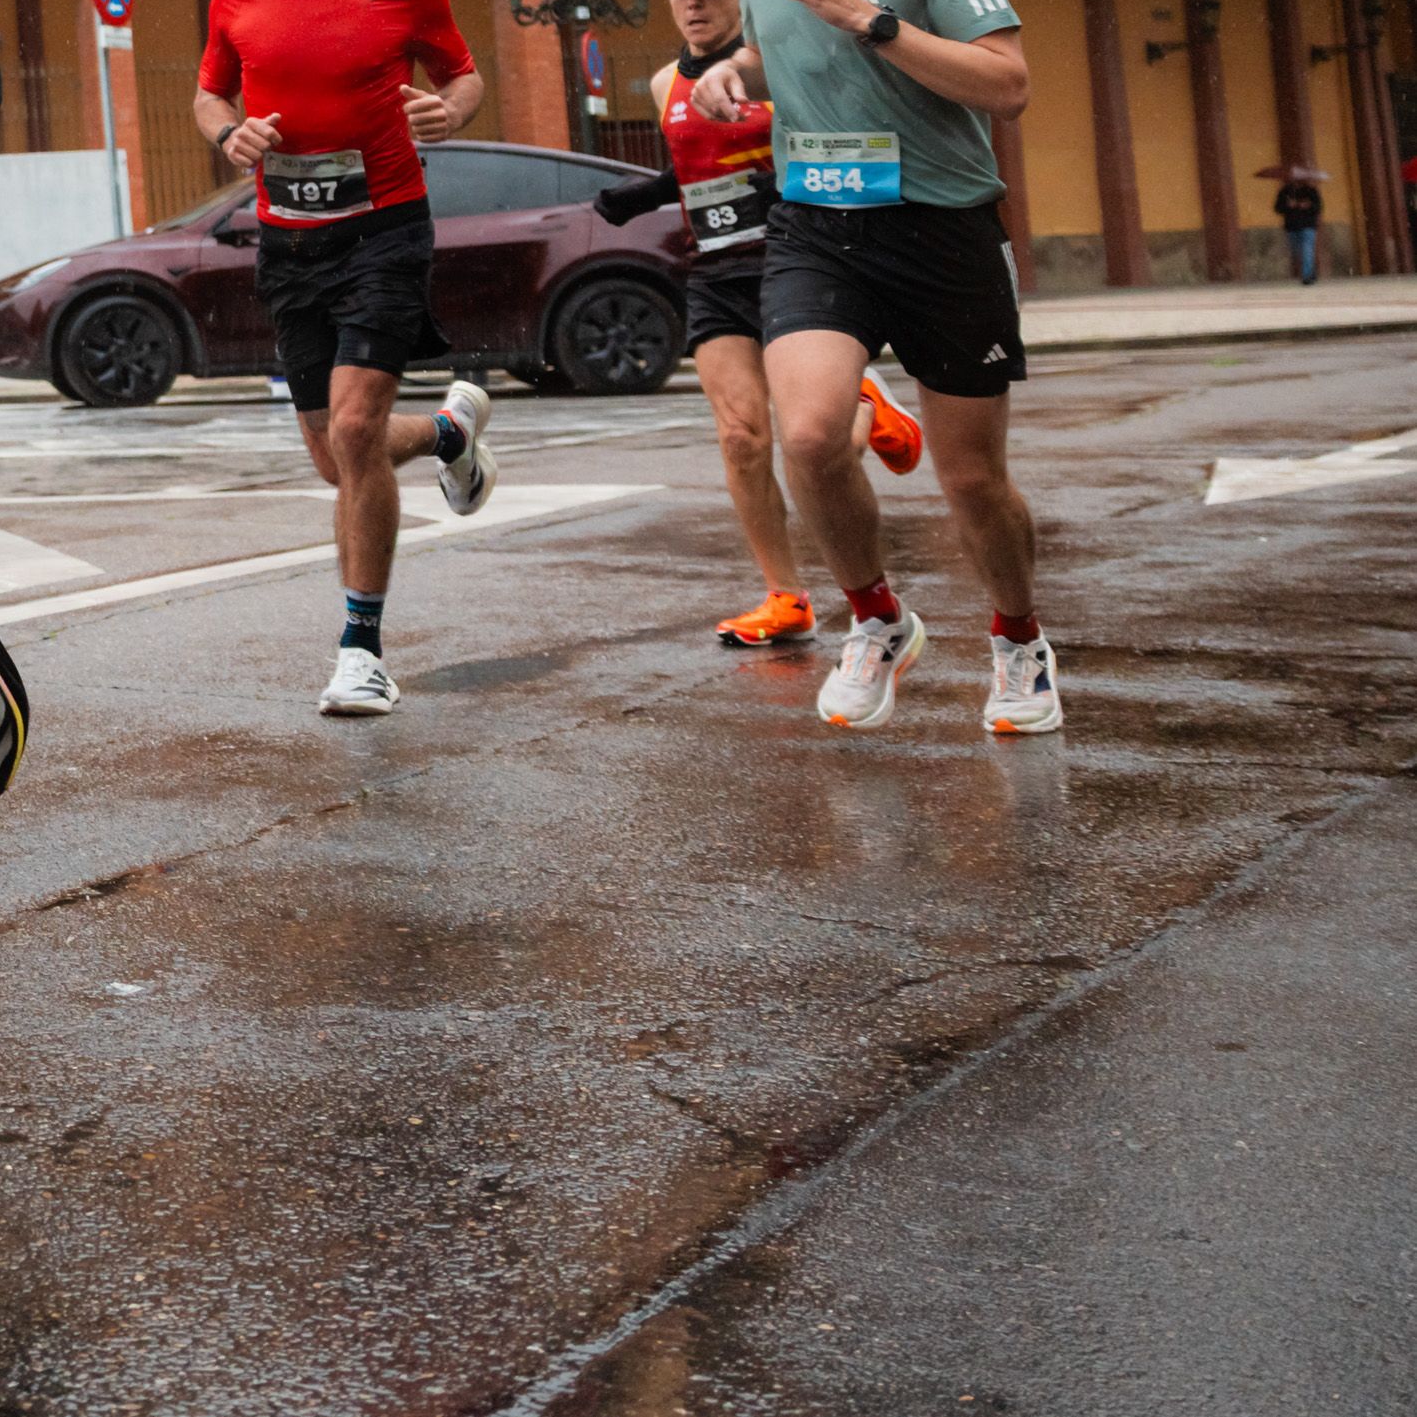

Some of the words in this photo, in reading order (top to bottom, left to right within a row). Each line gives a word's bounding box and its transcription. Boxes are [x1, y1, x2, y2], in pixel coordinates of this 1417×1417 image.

[803, 139, 814, 149] 42
[288, 181, 338, 202] 197
[804, 168, 865, 193] 854
[707, 205, 739, 229] 83
